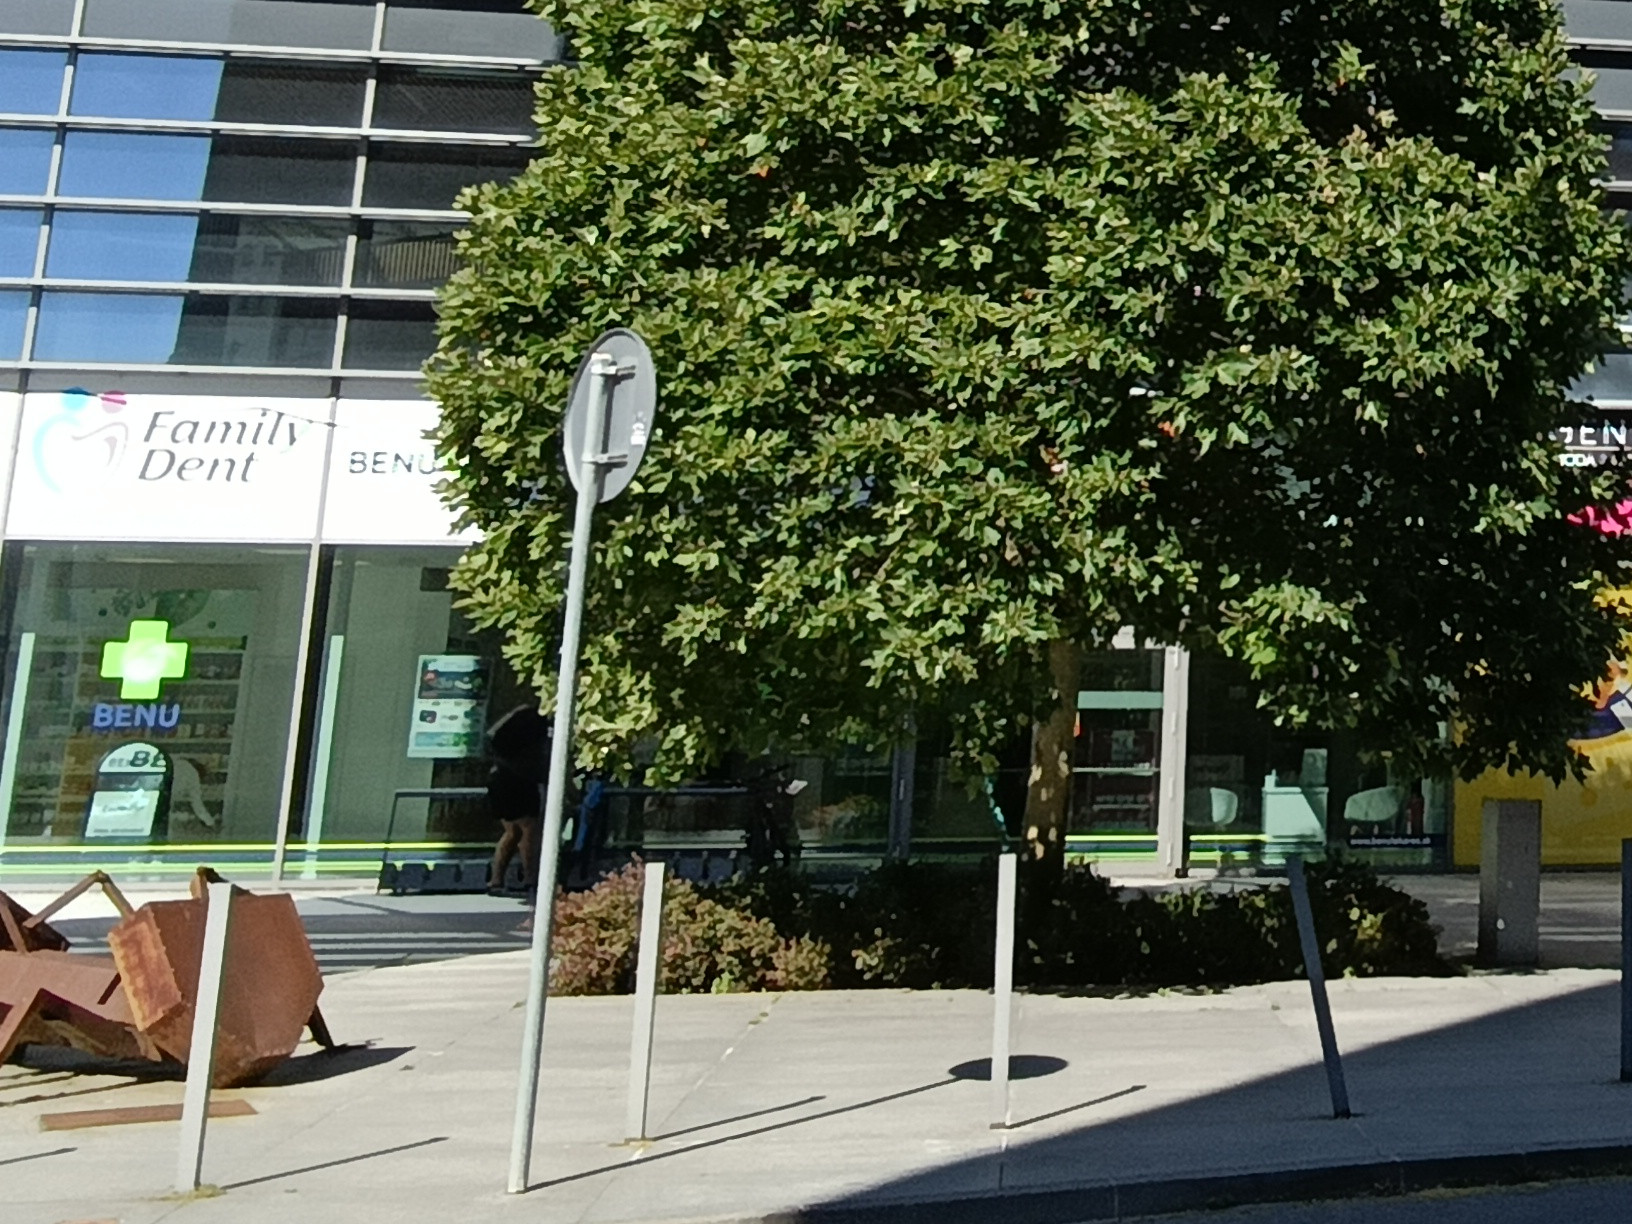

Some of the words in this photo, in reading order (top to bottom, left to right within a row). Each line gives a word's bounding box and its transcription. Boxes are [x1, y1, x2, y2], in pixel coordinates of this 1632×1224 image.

[143, 407, 306, 453] Family
[138, 448, 259, 483] Dent
[349, 450, 438, 475] BENU
[93, 702, 181, 728] BENU
